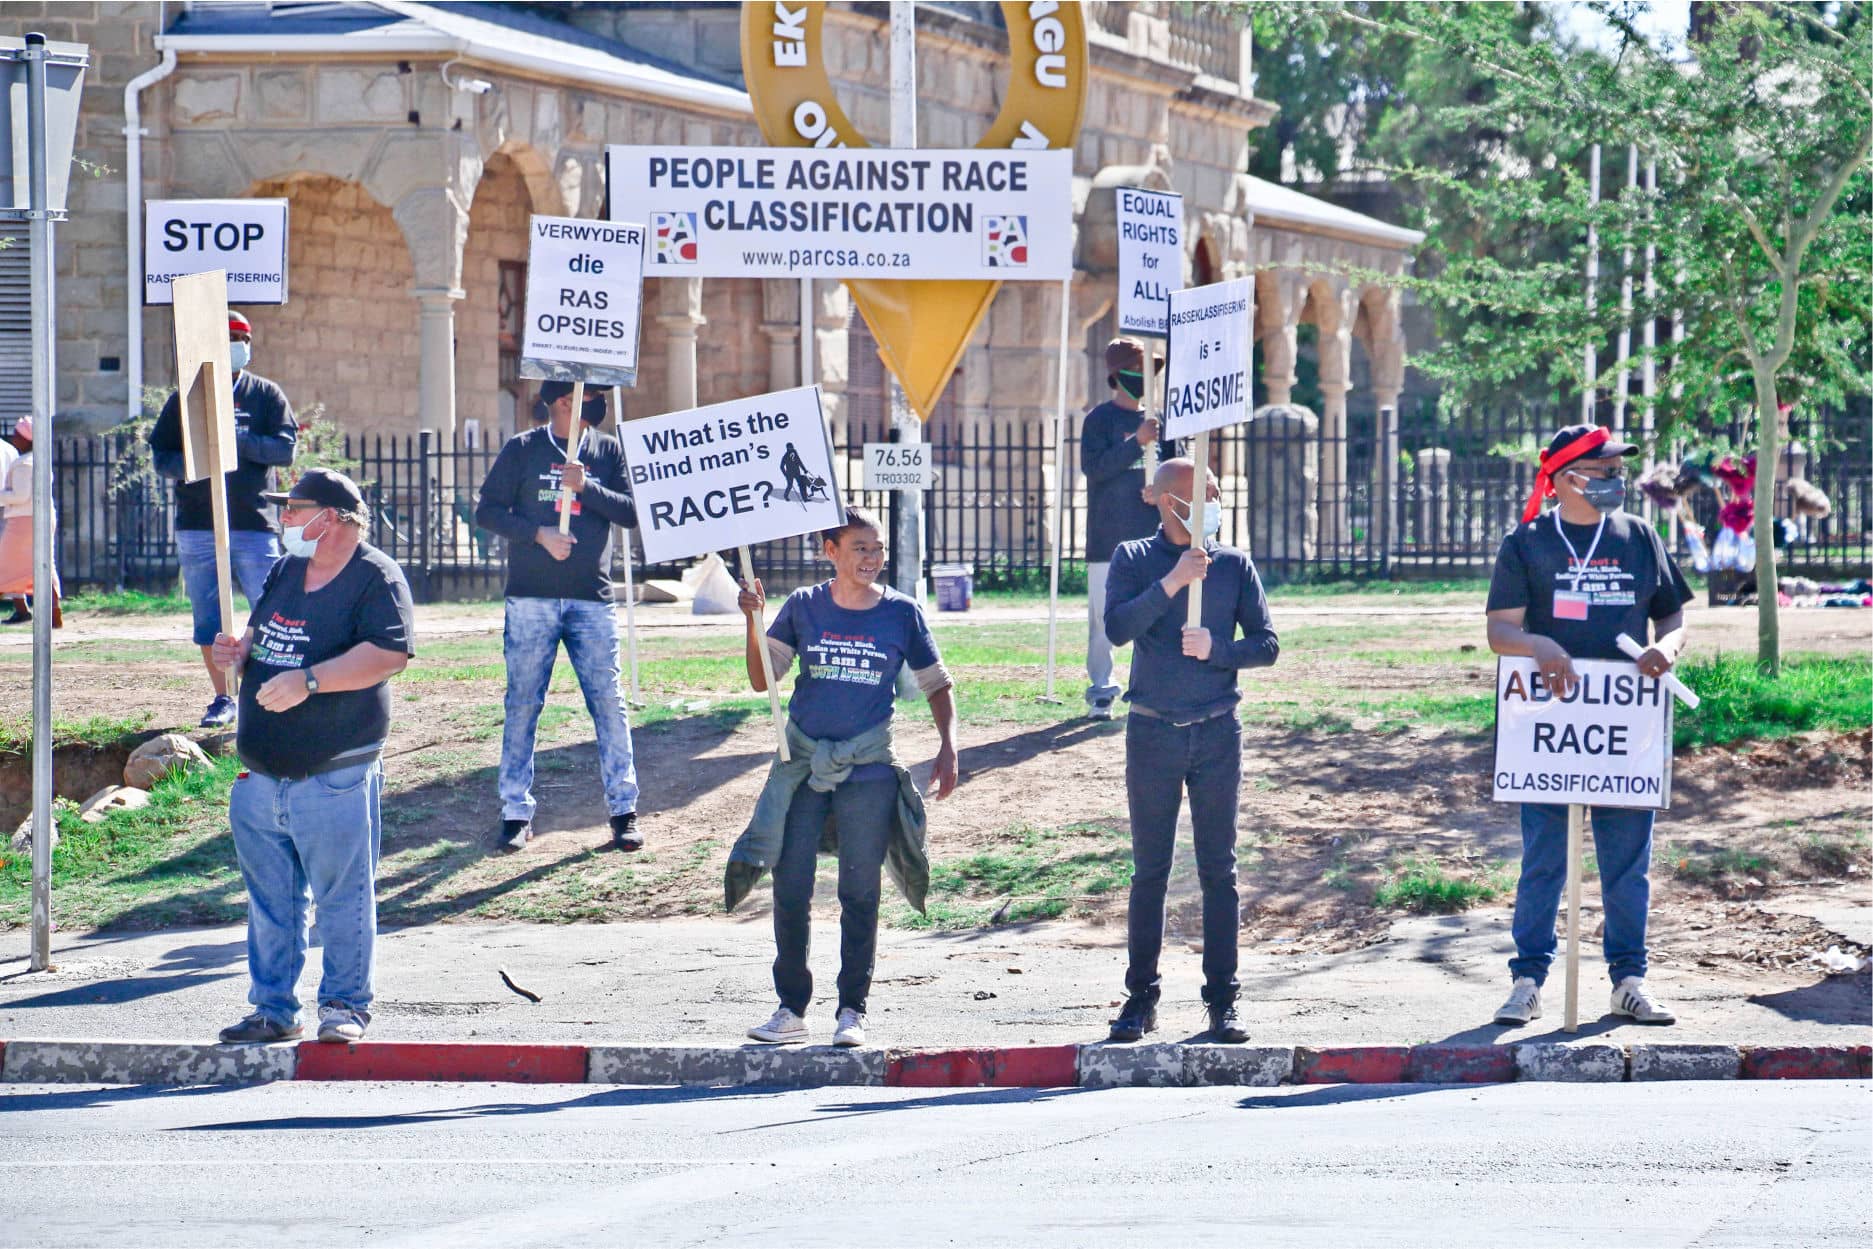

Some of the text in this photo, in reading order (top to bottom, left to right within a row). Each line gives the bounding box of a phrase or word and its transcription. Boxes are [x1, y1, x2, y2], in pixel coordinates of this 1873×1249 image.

[649, 157, 1027, 191] PEOPLE AGAINST RACE
[704, 200, 973, 233] CLASSIFICATION
[1123, 193, 1175, 218] EQUAL
[163, 218, 264, 252] STOP
[537, 223, 640, 245] VERWYDER
[1123, 222, 1178, 246] RIGHTS
[568, 253, 604, 274] die
[743, 249, 911, 271] www.parcsa.co.za
[1142, 252, 1159, 269] for
[560, 288, 608, 310] RAS
[1124, 314, 1156, 329] Abolish
[1171, 298, 1246, 327] RASSEKLASSIFISERING
[538, 314, 624, 339] OPSIES
[1199, 339, 1209, 361] is
[1168, 370, 1244, 420] RASISME
[642, 411, 790, 454] What is the
[631, 455, 692, 485] Blind
[875, 449, 922, 467] 76.56
[875, 473, 921, 485] TR03302
[650, 480, 774, 531] RACE?
[820, 652, 870, 669] I am a
[1533, 722, 1629, 756] RACE
[1496, 771, 1660, 795] CLASSIFICATION
